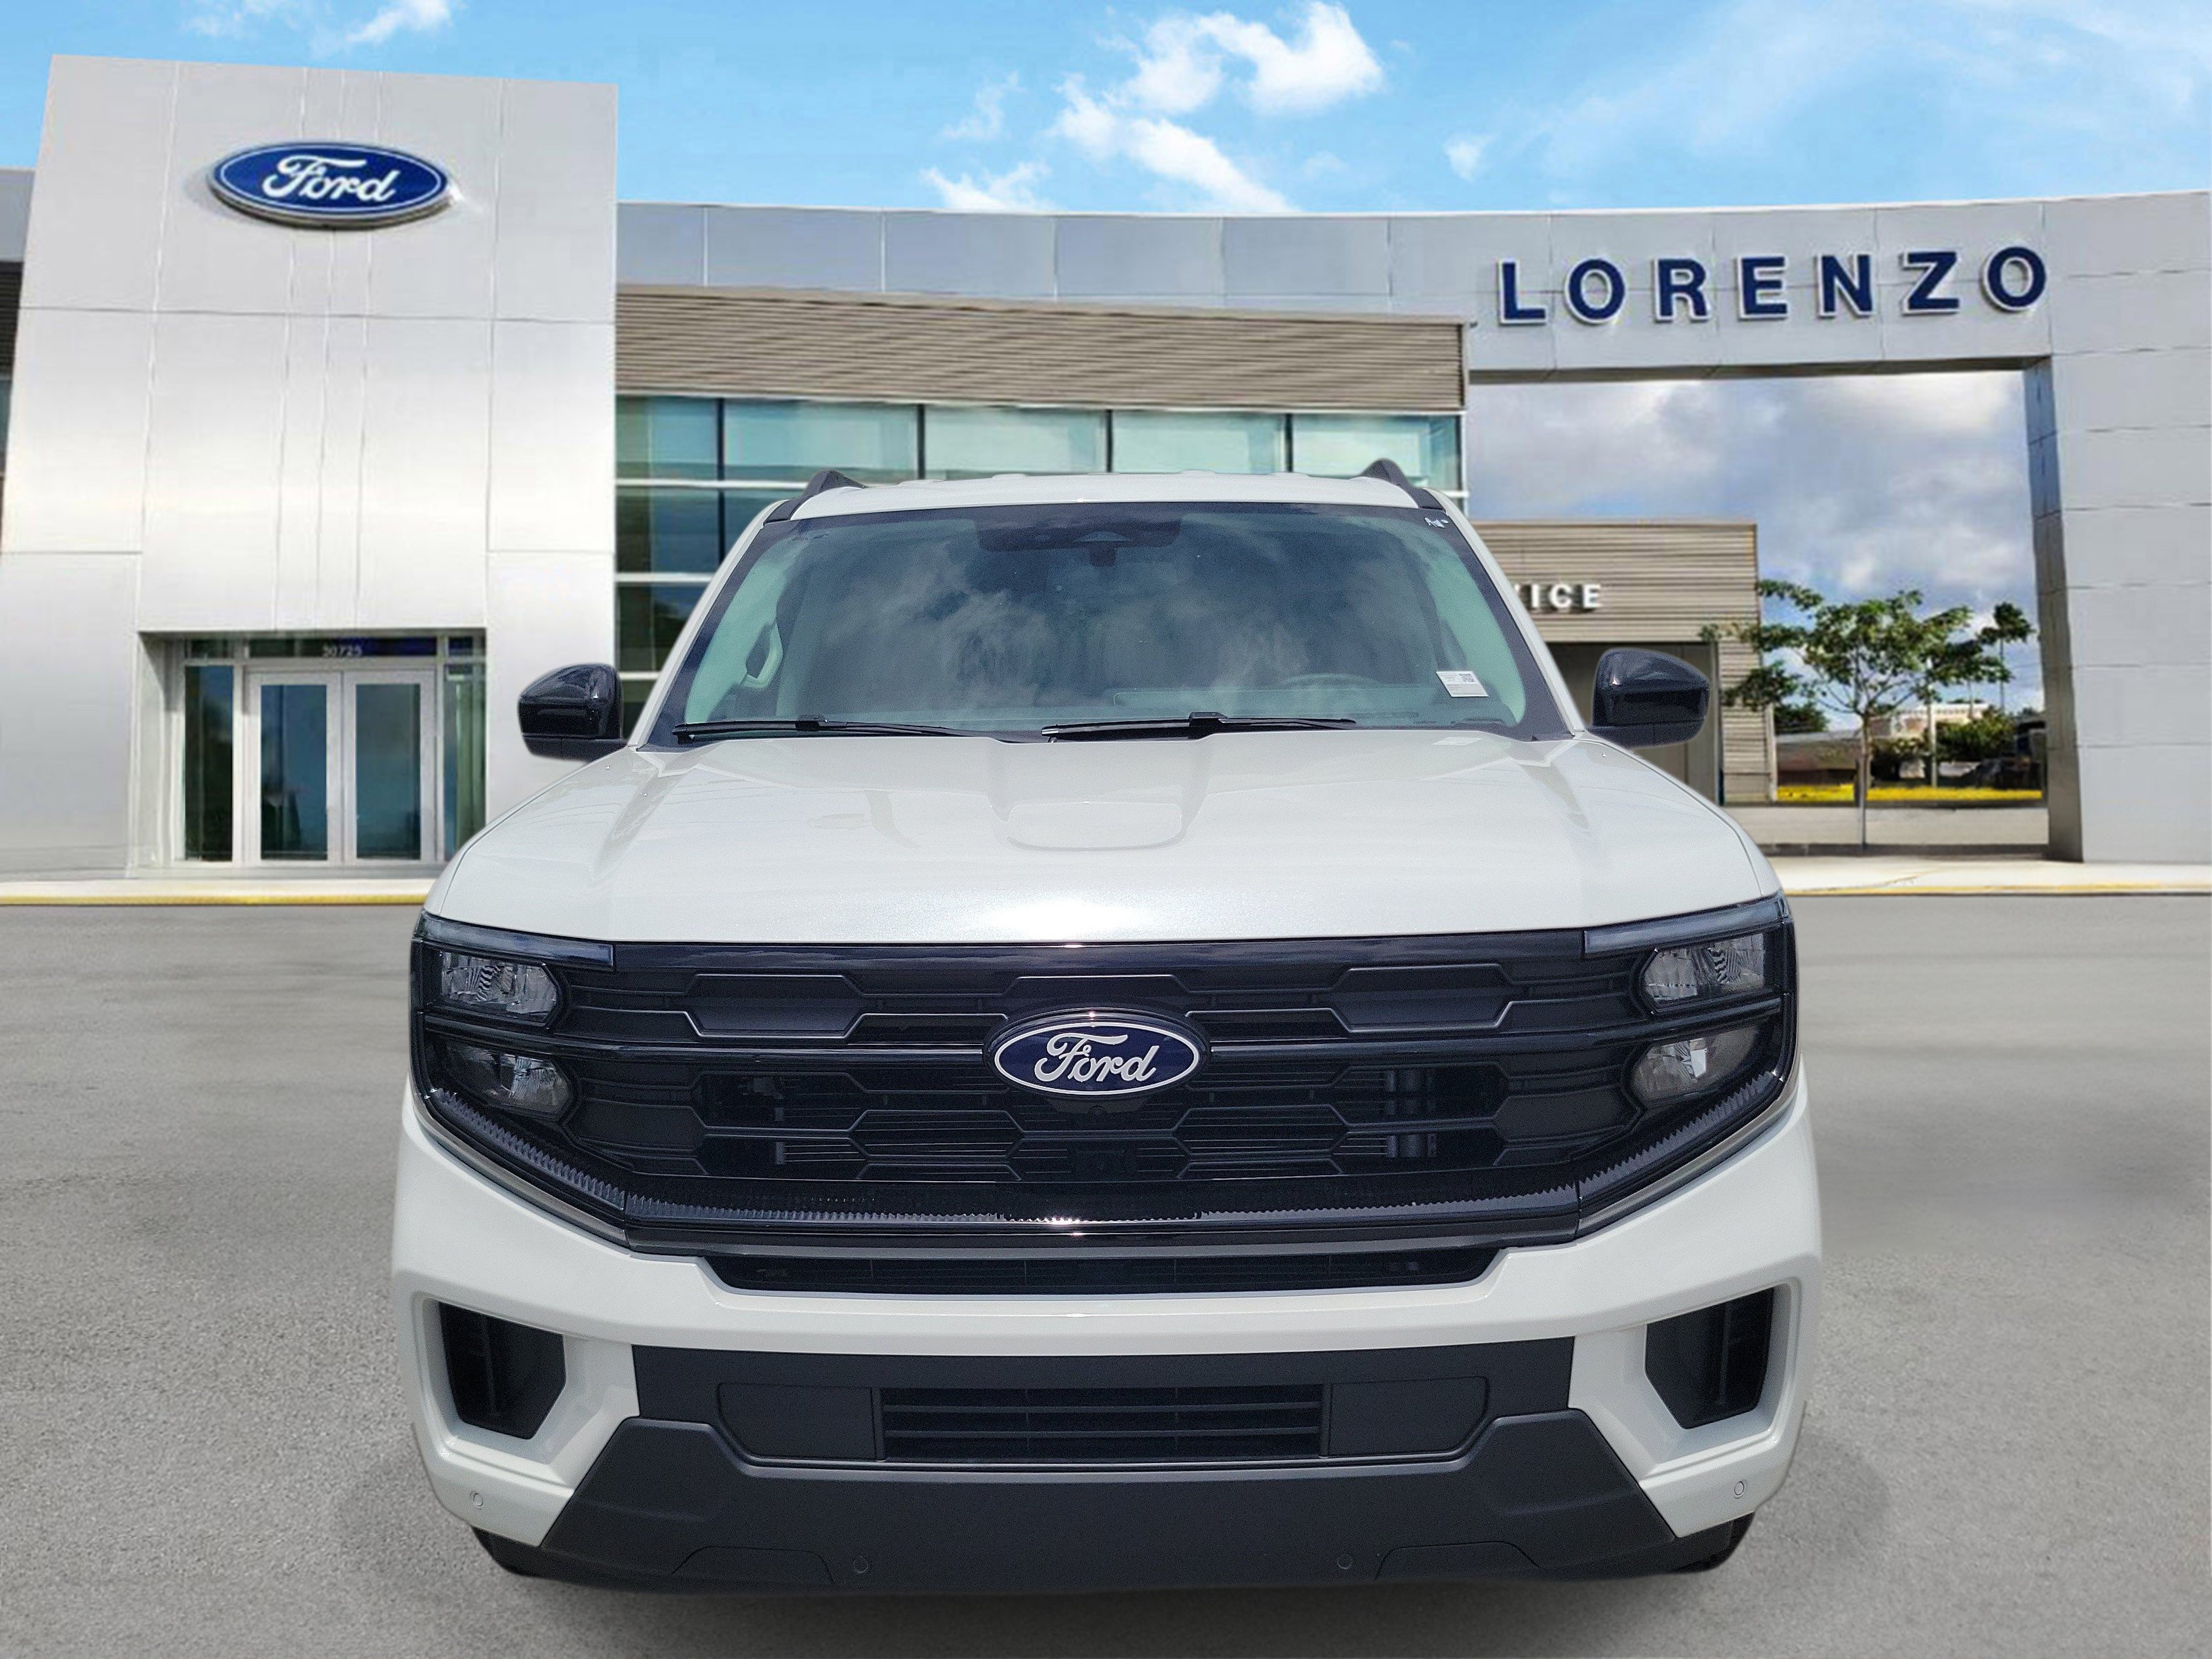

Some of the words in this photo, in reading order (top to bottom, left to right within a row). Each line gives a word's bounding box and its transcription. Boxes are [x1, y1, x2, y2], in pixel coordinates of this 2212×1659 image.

[263, 155, 398, 201] Ford
[1498, 246, 2047, 324] LORENZO
[1515, 584, 1601, 608] ICE
[1034, 1033, 1159, 1082] Ford
